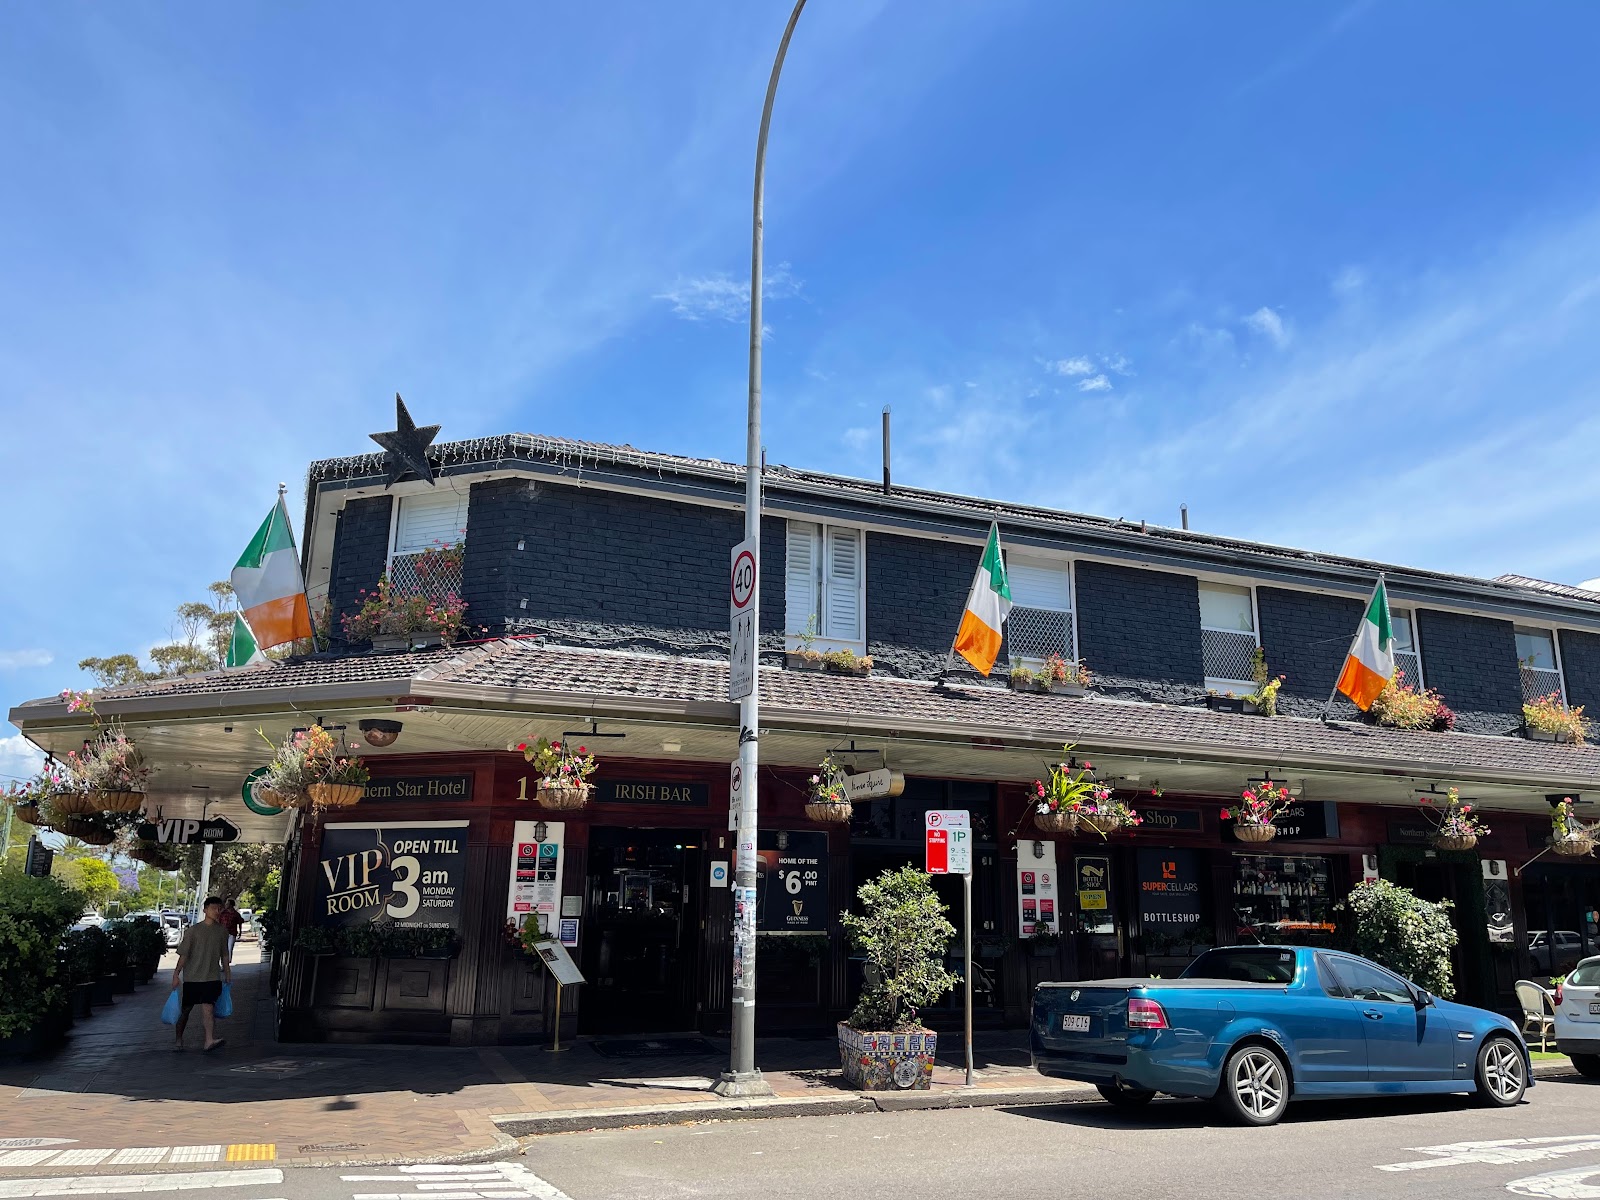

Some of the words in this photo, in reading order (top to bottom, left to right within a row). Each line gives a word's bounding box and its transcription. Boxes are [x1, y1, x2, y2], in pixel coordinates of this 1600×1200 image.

[735, 564, 752, 593] 40
[363, 782, 391, 798] hern
[396, 781, 424, 797] Star
[427, 778, 466, 796] Hotel
[614, 784, 655, 799] IRISH
[660, 787, 691, 801] BAR
[1146, 811, 1178, 828] Shop
[157, 819, 200, 843] VIP
[203, 828, 223, 838] ROOM
[952, 831, 966, 843] 1P
[1277, 827, 1301, 836] SHOP
[1399, 828, 1425, 836] Northern
[393, 840, 430, 854] OPEN
[433, 839, 459, 854] TILL
[778, 857, 796, 865] HOME
[320, 849, 383, 893] VIP
[421, 870, 449, 885] am
[386, 855, 420, 919] 3
[422, 886, 456, 896] MONDAY
[1142, 881, 1199, 892] SUPERCELLARS
[327, 888, 381, 916] ROOM
[422, 899, 455, 908] SATURDAY
[1143, 913, 1200, 922] BOTTLESHOP
